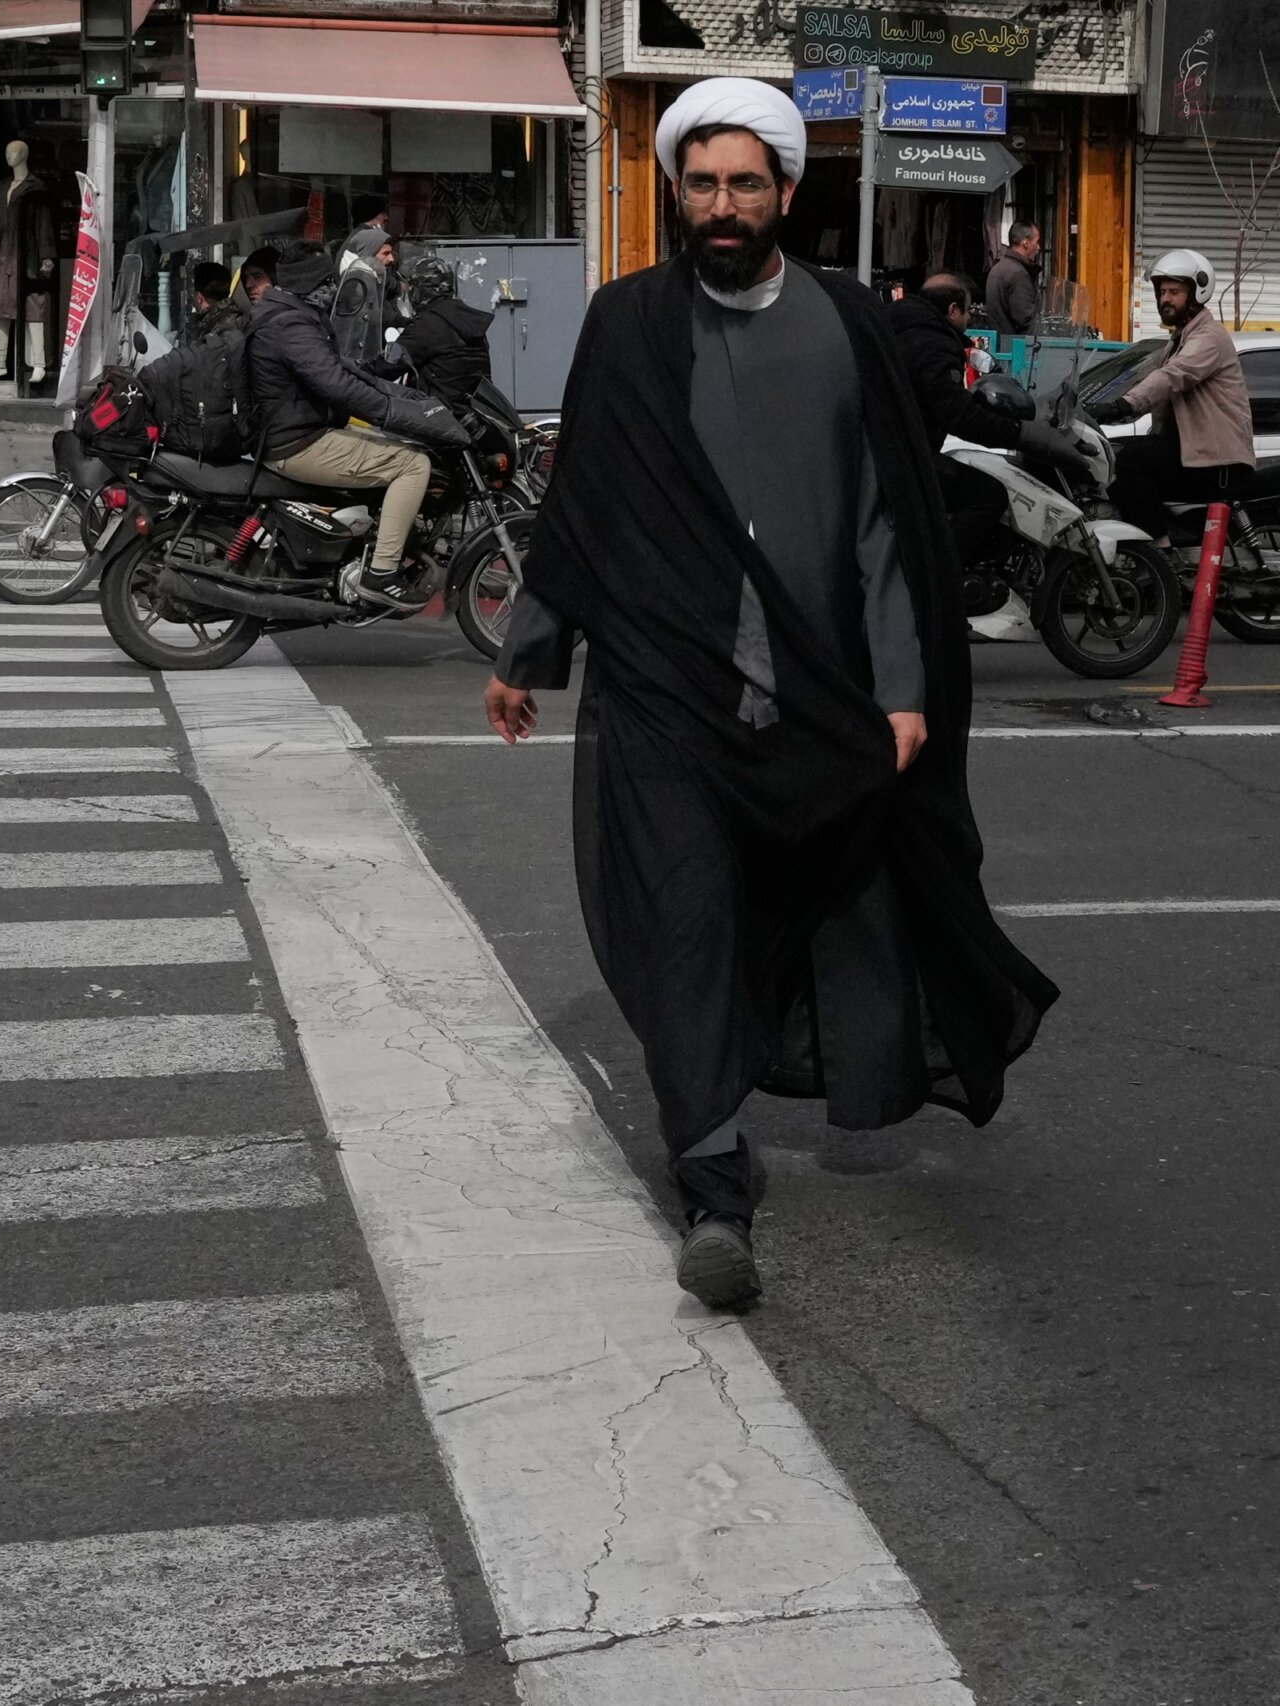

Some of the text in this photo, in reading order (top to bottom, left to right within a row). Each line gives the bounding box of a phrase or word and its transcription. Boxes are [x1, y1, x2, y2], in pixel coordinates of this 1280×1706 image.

[804, 12, 871, 38] SALSA
[880, 17, 945, 43] سالسا
[951, 26, 1030, 55] تولیدی
[848, 47, 933, 69] @salsagroup
[807, 82, 842, 108] ولیعصر
[961, 83, 980, 91] خیابان
[892, 95, 976, 111] جمهوری اسلامی
[892, 118, 978, 129] JOMHURI ESLAMI ST.
[895, 167, 986, 184] Famouri House
